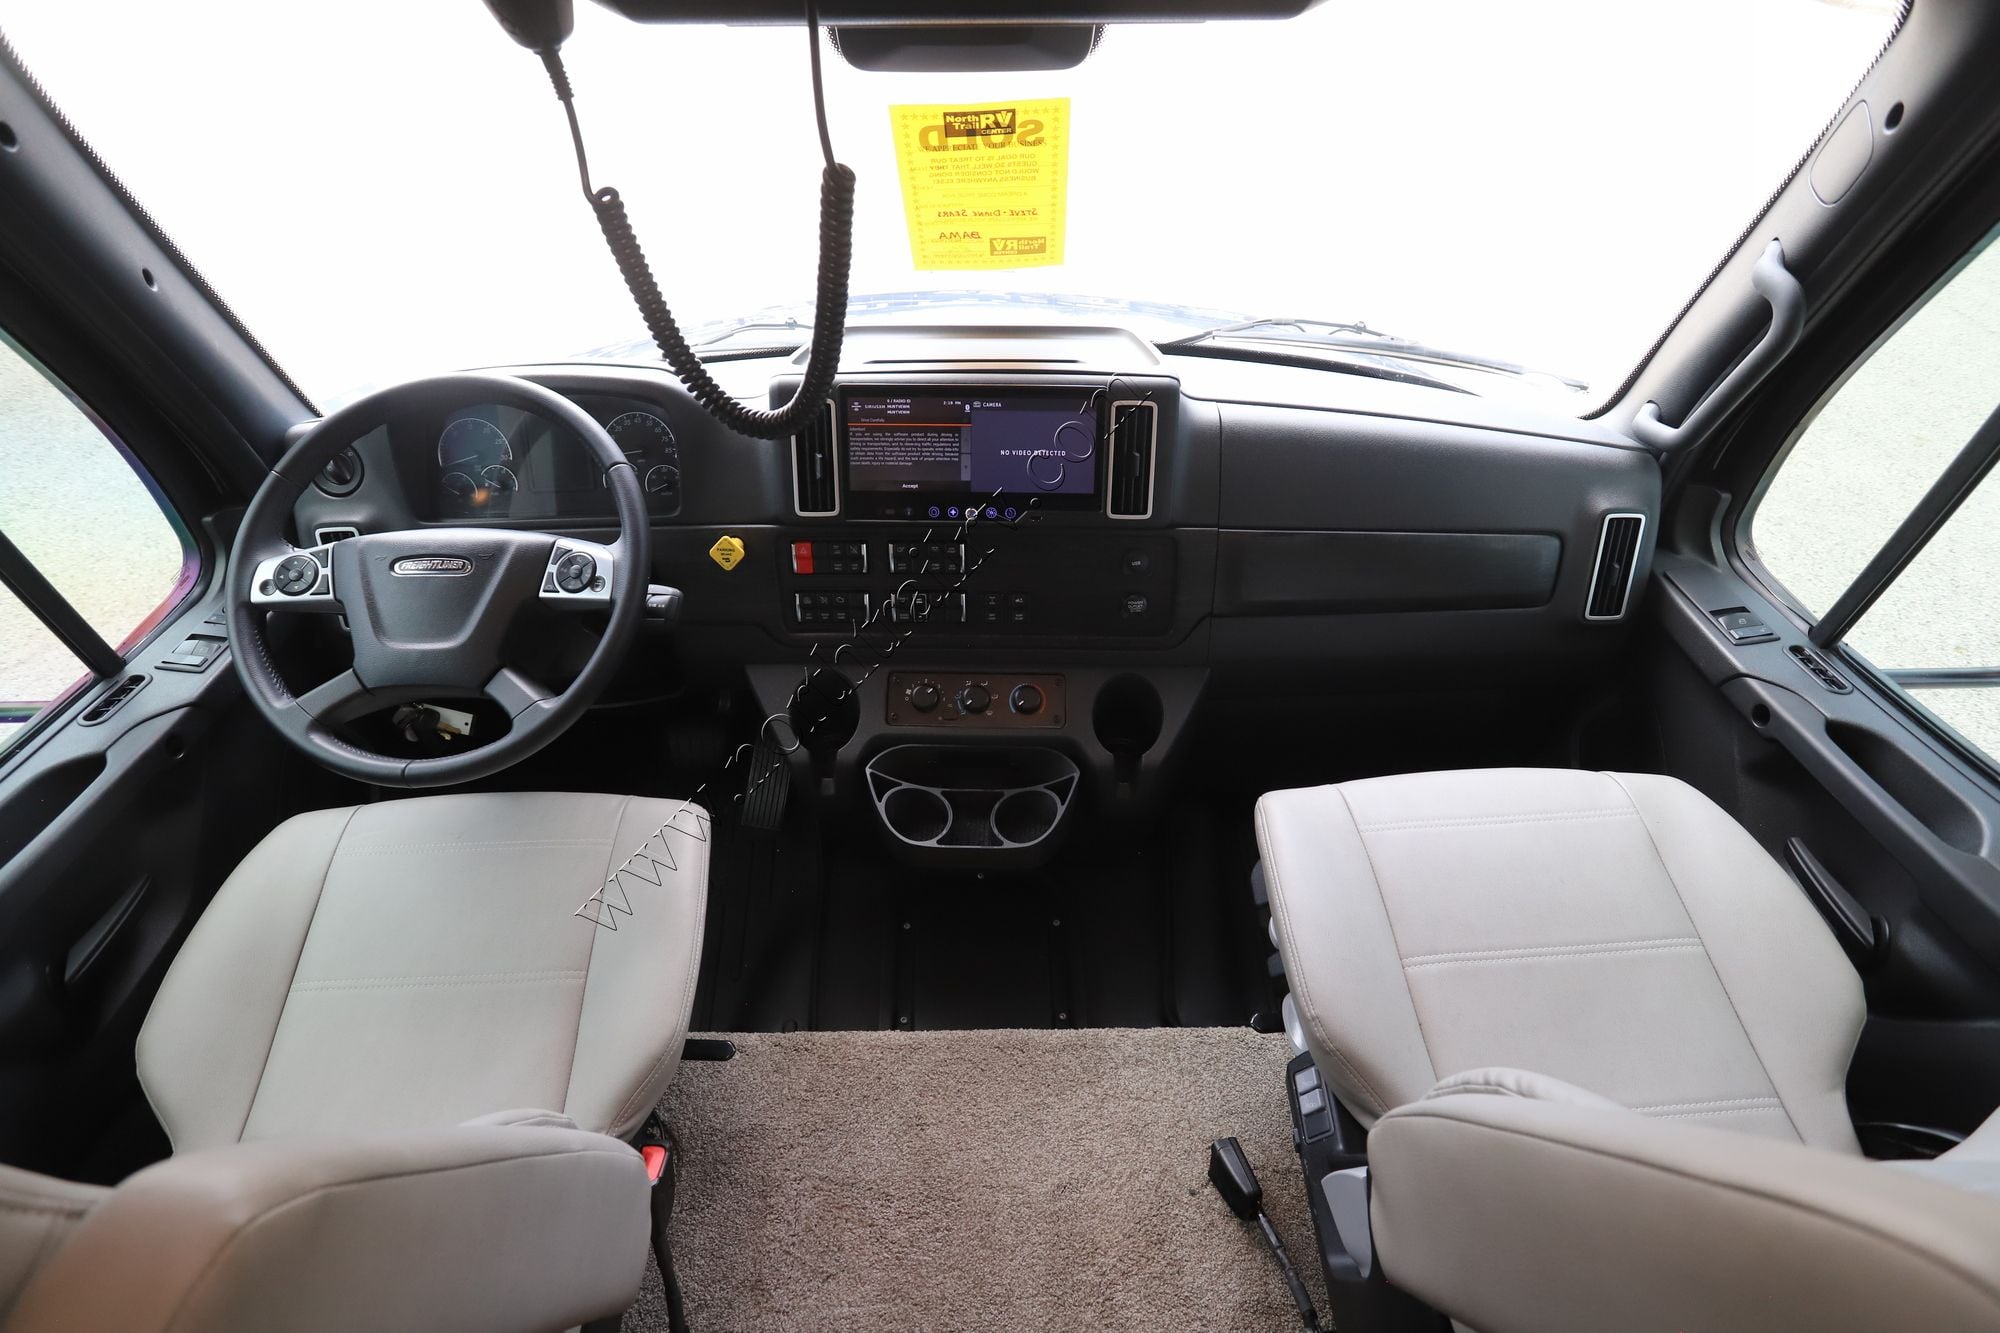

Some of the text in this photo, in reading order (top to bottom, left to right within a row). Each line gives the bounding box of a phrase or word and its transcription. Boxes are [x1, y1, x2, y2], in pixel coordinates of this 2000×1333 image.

[946, 110, 1013, 129] North RV
[953, 121, 980, 131] Trail
[981, 127, 1012, 136] CENTER
[400, 560, 464, 570] FREIGHTLINER
